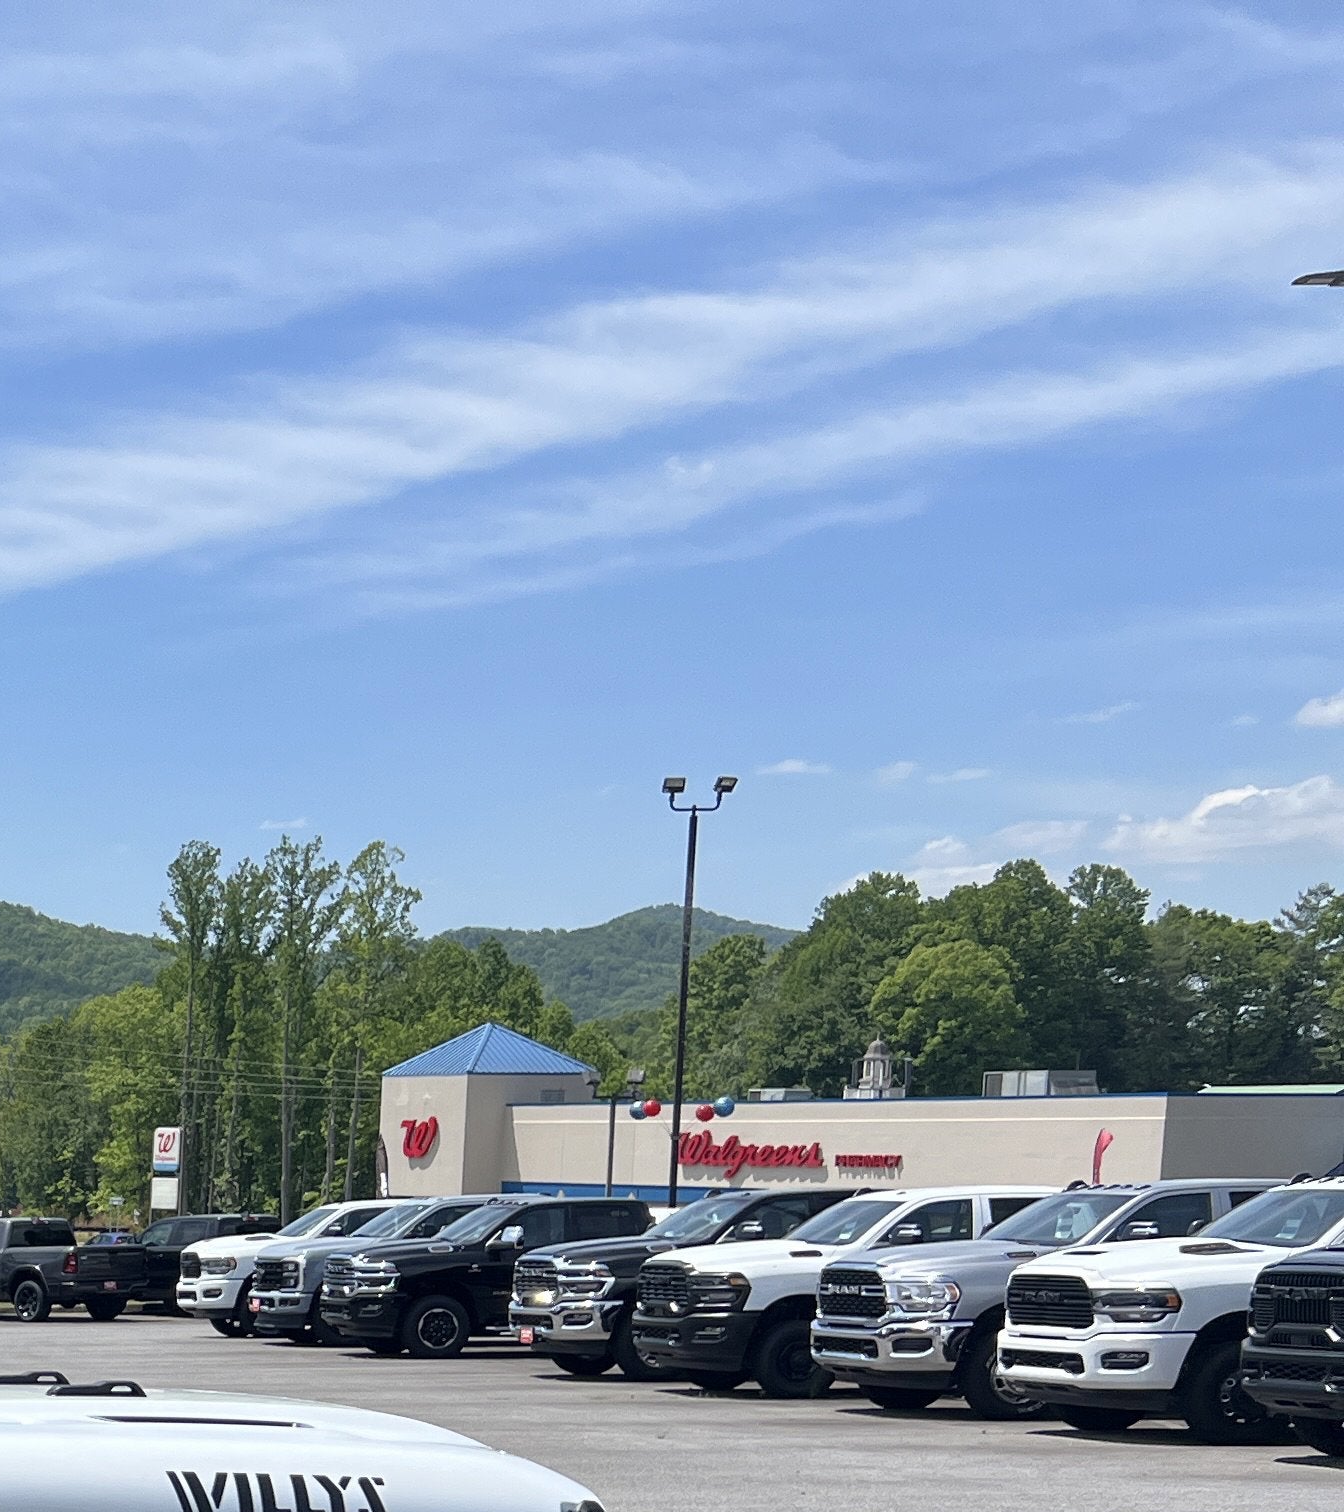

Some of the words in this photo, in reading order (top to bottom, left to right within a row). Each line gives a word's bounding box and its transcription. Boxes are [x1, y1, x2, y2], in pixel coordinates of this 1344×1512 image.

[157, 1132, 176, 1153] W
[400, 1116, 438, 1158] W
[678, 1129, 825, 1180] Walgreens
